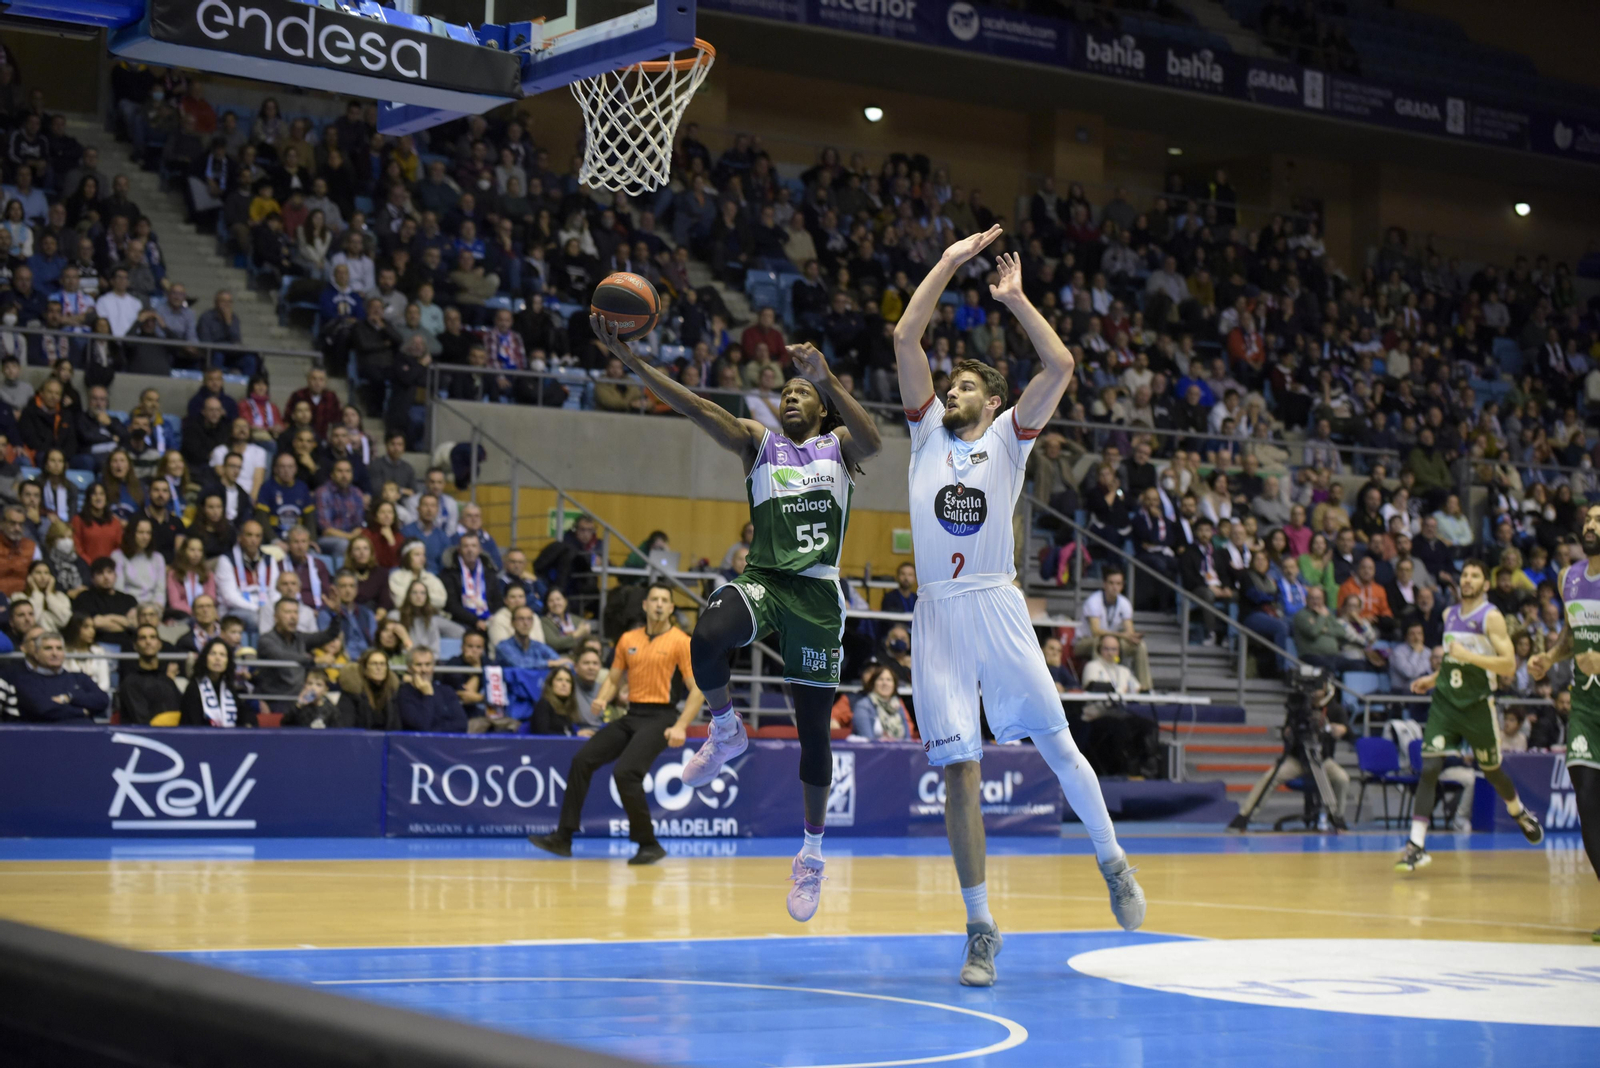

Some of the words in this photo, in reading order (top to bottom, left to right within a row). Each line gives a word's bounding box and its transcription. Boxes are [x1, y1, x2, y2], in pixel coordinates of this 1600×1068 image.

[196, 0, 428, 80] endesa
[943, 504, 980, 522] Galicia
[796, 522, 830, 554] 55
[951, 552, 966, 580] 2
[1449, 668, 1464, 689] 8
